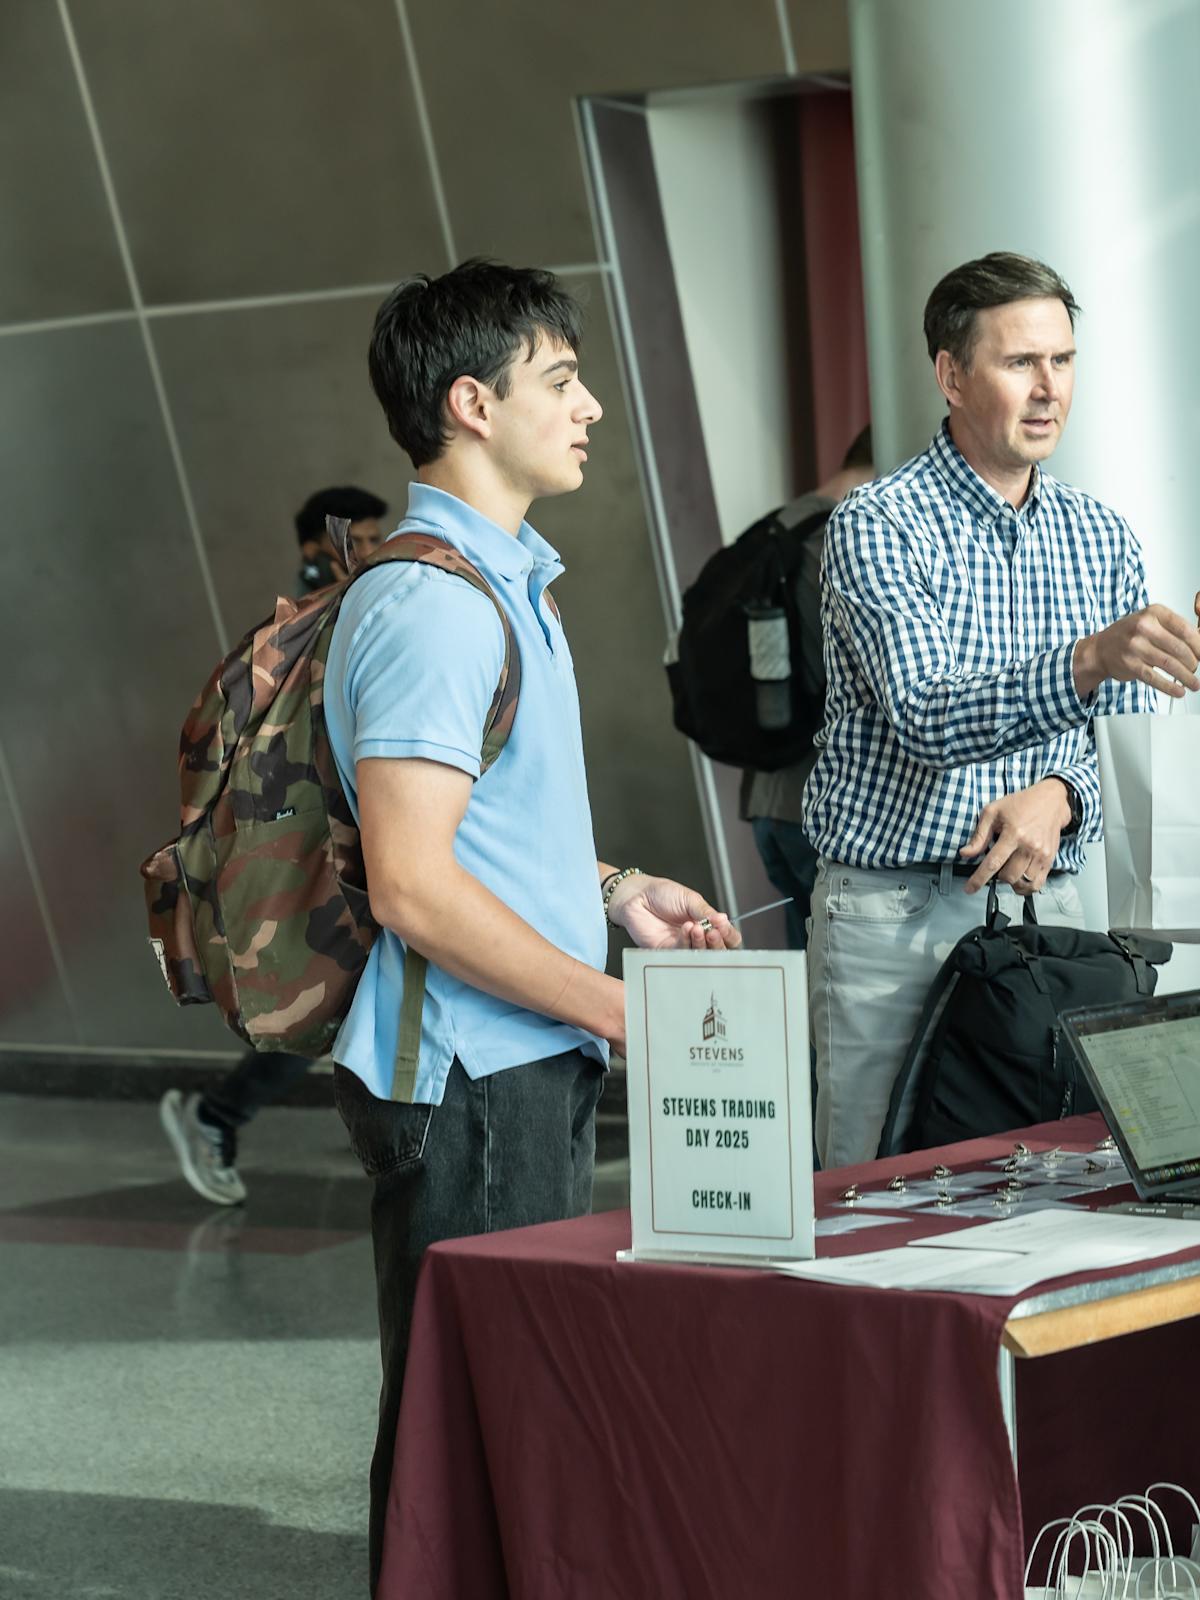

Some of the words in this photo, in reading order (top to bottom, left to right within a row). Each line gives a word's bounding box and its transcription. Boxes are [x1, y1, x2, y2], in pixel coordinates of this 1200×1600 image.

[689, 1047, 744, 1061] STEVENS
[663, 1097, 716, 1117] STEVENS
[721, 1099, 776, 1119] TRADING
[686, 1128, 710, 1148] DAY
[715, 1130, 749, 1149] 2025
[692, 1190, 751, 1211] CHECK-IN
